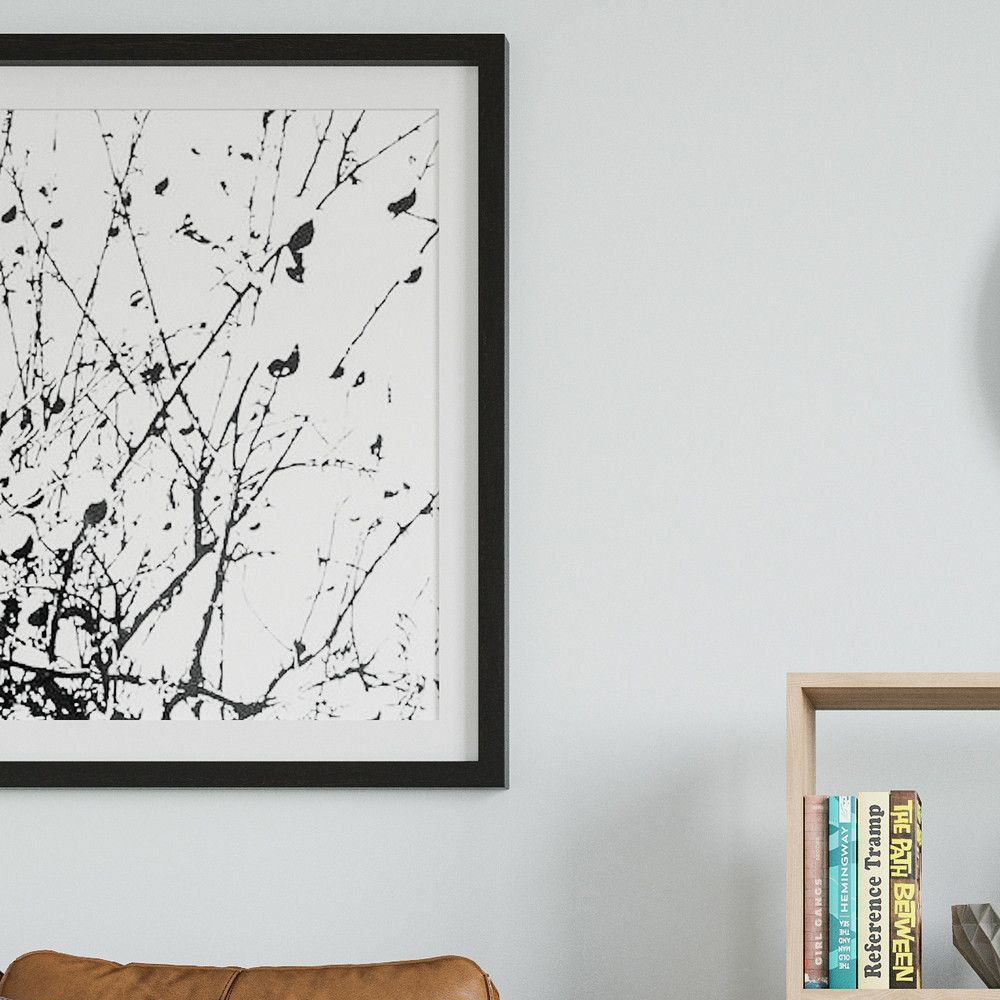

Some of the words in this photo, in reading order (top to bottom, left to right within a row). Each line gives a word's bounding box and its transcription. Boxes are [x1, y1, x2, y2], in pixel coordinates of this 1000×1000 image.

[865, 804, 884, 870] Tramp
[890, 799, 913, 834] THE
[840, 826, 850, 912] HEMINGWAY
[890, 838, 912, 877] PATH
[814, 878, 823, 928] GANGS
[864, 876, 882, 978] Reference
[814, 935, 823, 966] GIRL
[893, 883, 916, 982] BETWEEN
